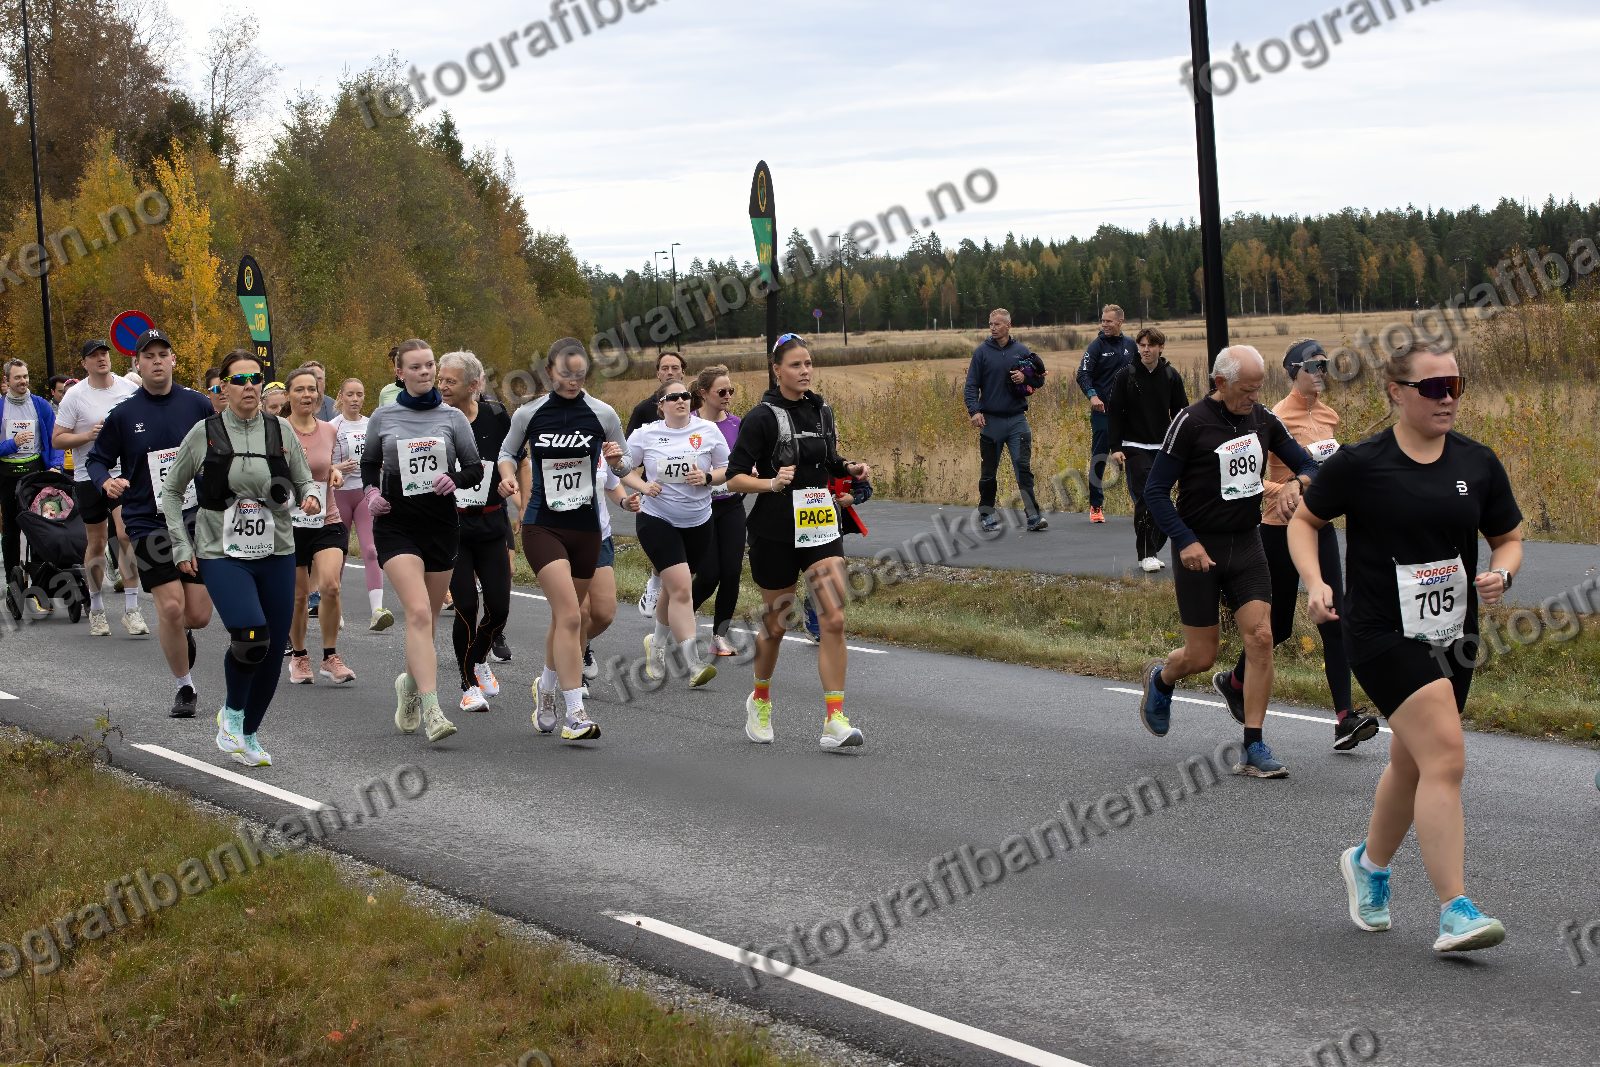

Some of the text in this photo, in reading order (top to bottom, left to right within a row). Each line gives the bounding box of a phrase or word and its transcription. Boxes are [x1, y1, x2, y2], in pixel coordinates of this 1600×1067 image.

[408, 440, 437, 449] NORGES
[409, 455, 438, 475] 573
[665, 463, 690, 478] 479
[1229, 455, 1257, 477] 898
[553, 472, 582, 492] 707
[799, 509, 834, 526] PACE
[233, 518, 266, 537] 450
[1413, 564, 1459, 579] NORGES
[1418, 573, 1453, 586] LØPET
[1415, 586, 1455, 620] 705
